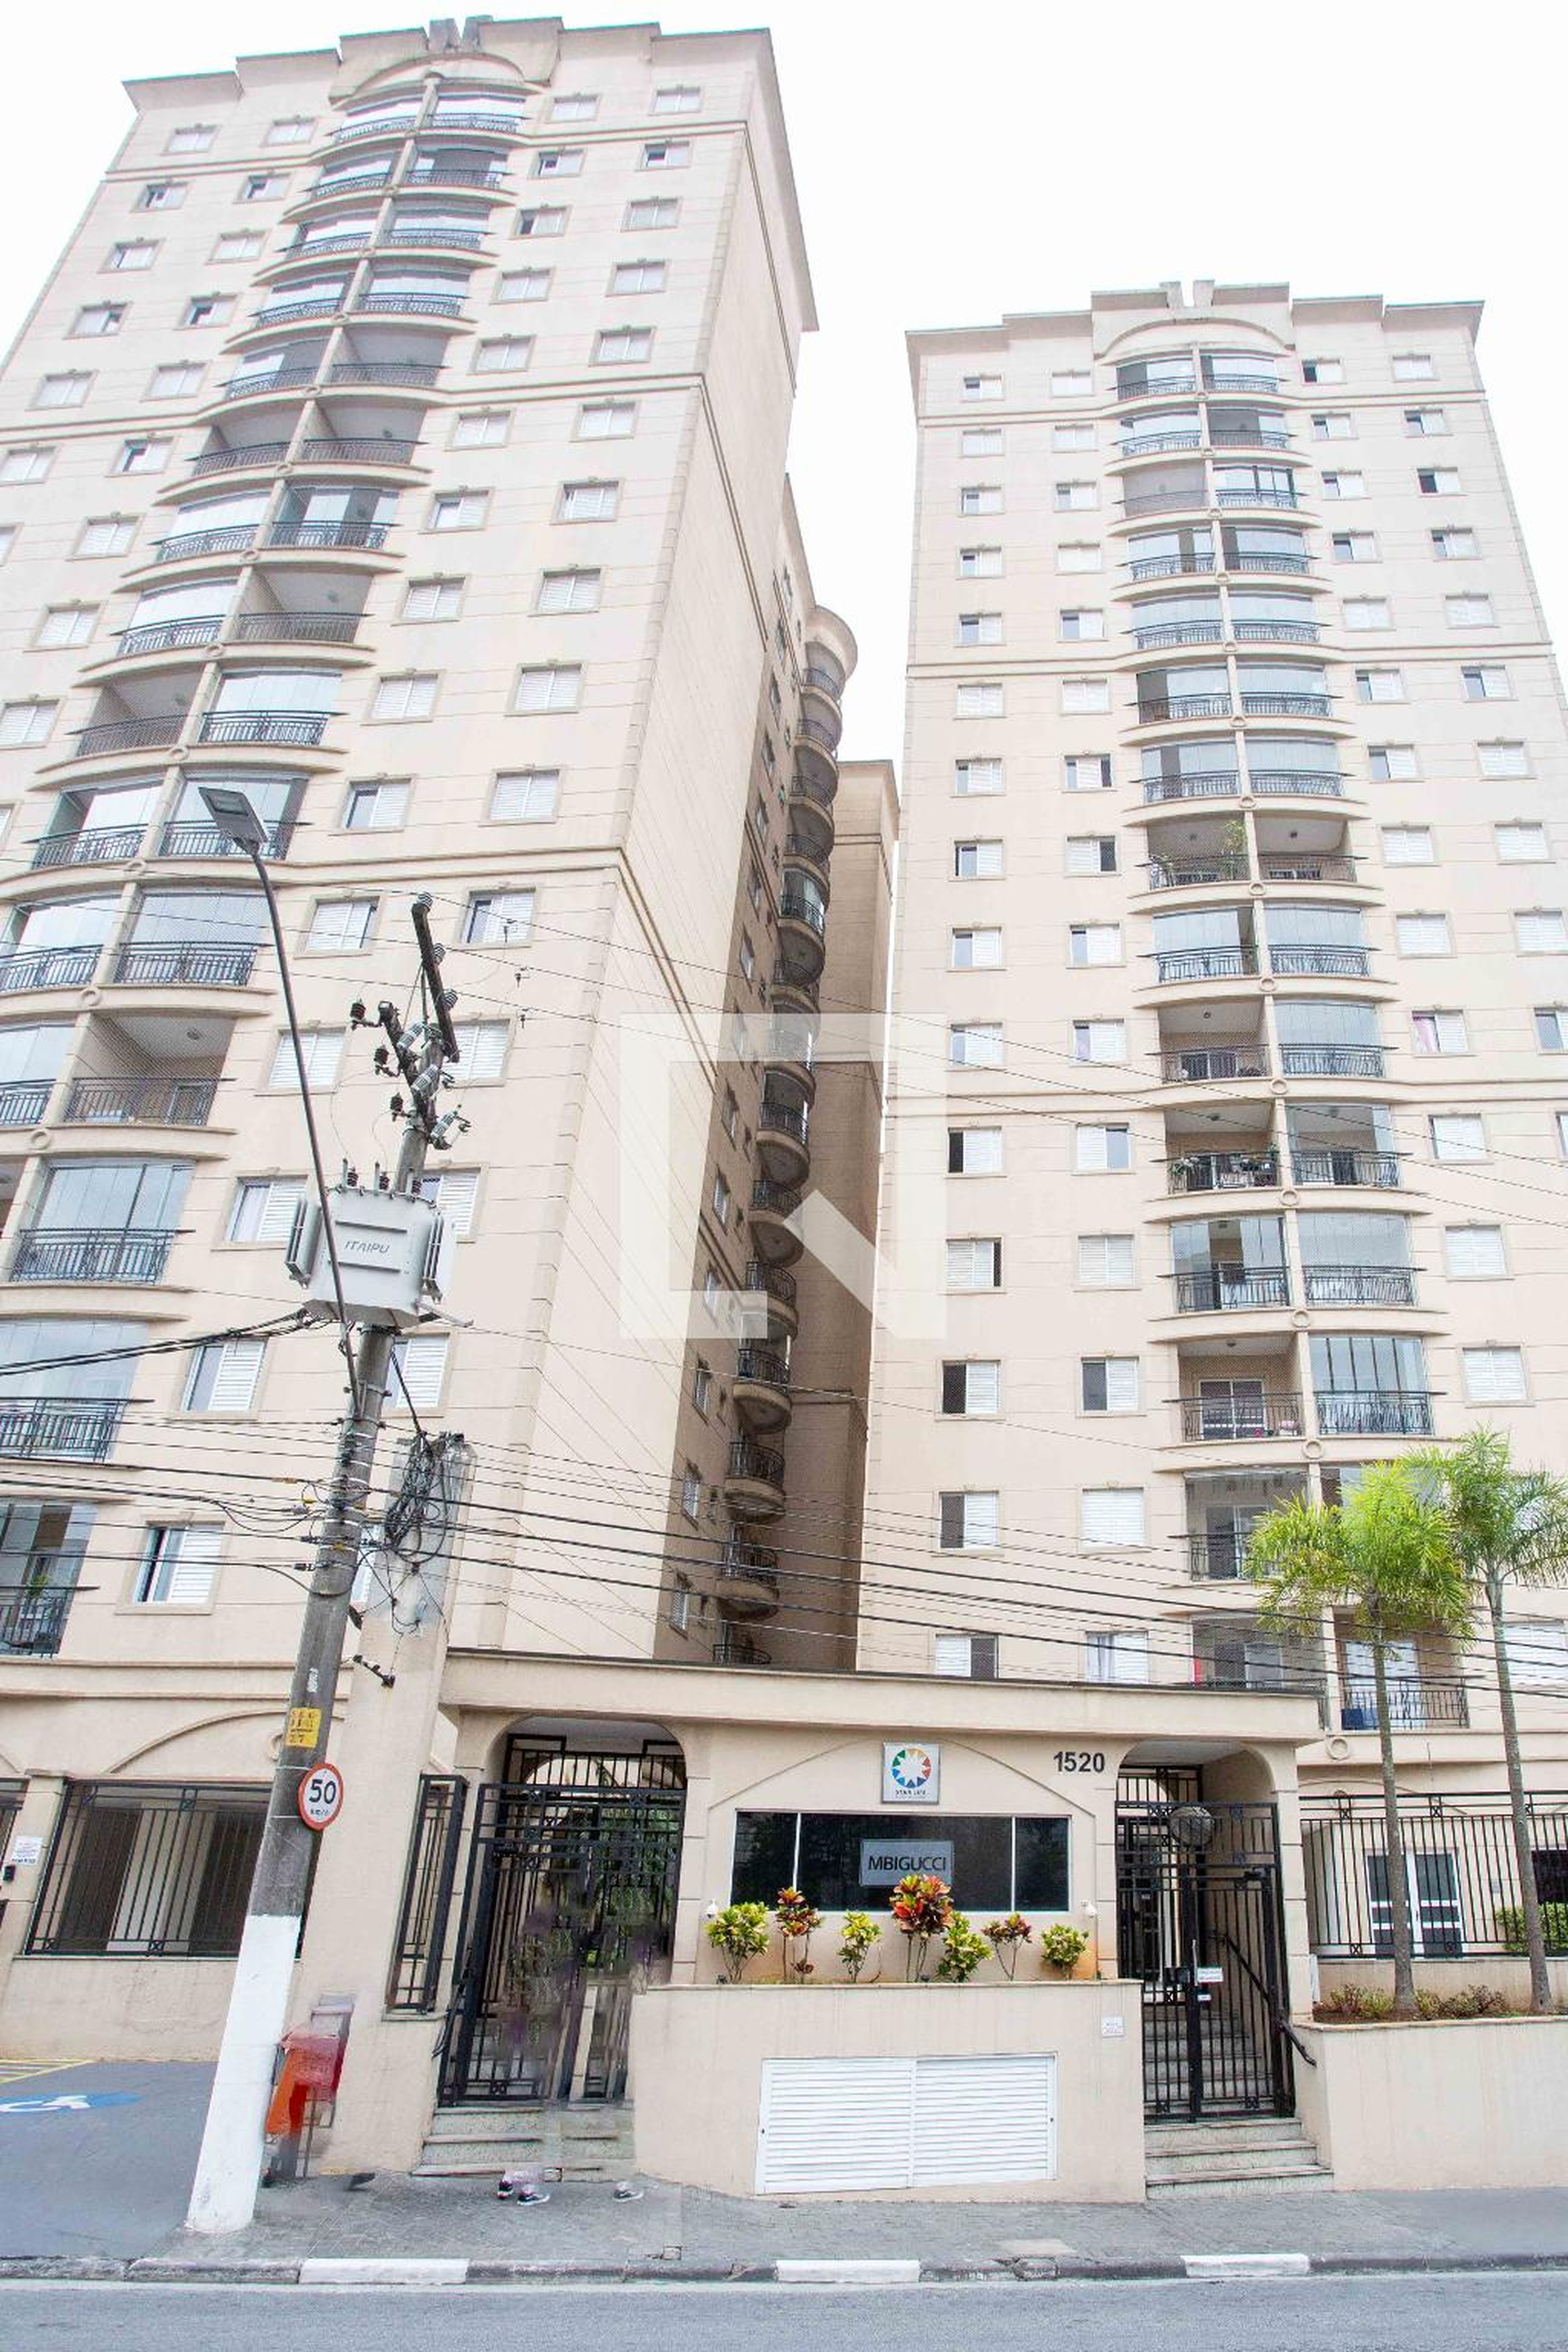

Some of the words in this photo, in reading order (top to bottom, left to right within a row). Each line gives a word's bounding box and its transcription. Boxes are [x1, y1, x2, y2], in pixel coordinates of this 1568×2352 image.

[344, 1241, 390, 1253] ITAIPU
[1054, 1751, 1105, 1773] 1520
[309, 1779, 336, 1804] 50
[869, 1855, 946, 1871] MBIGUCCI
